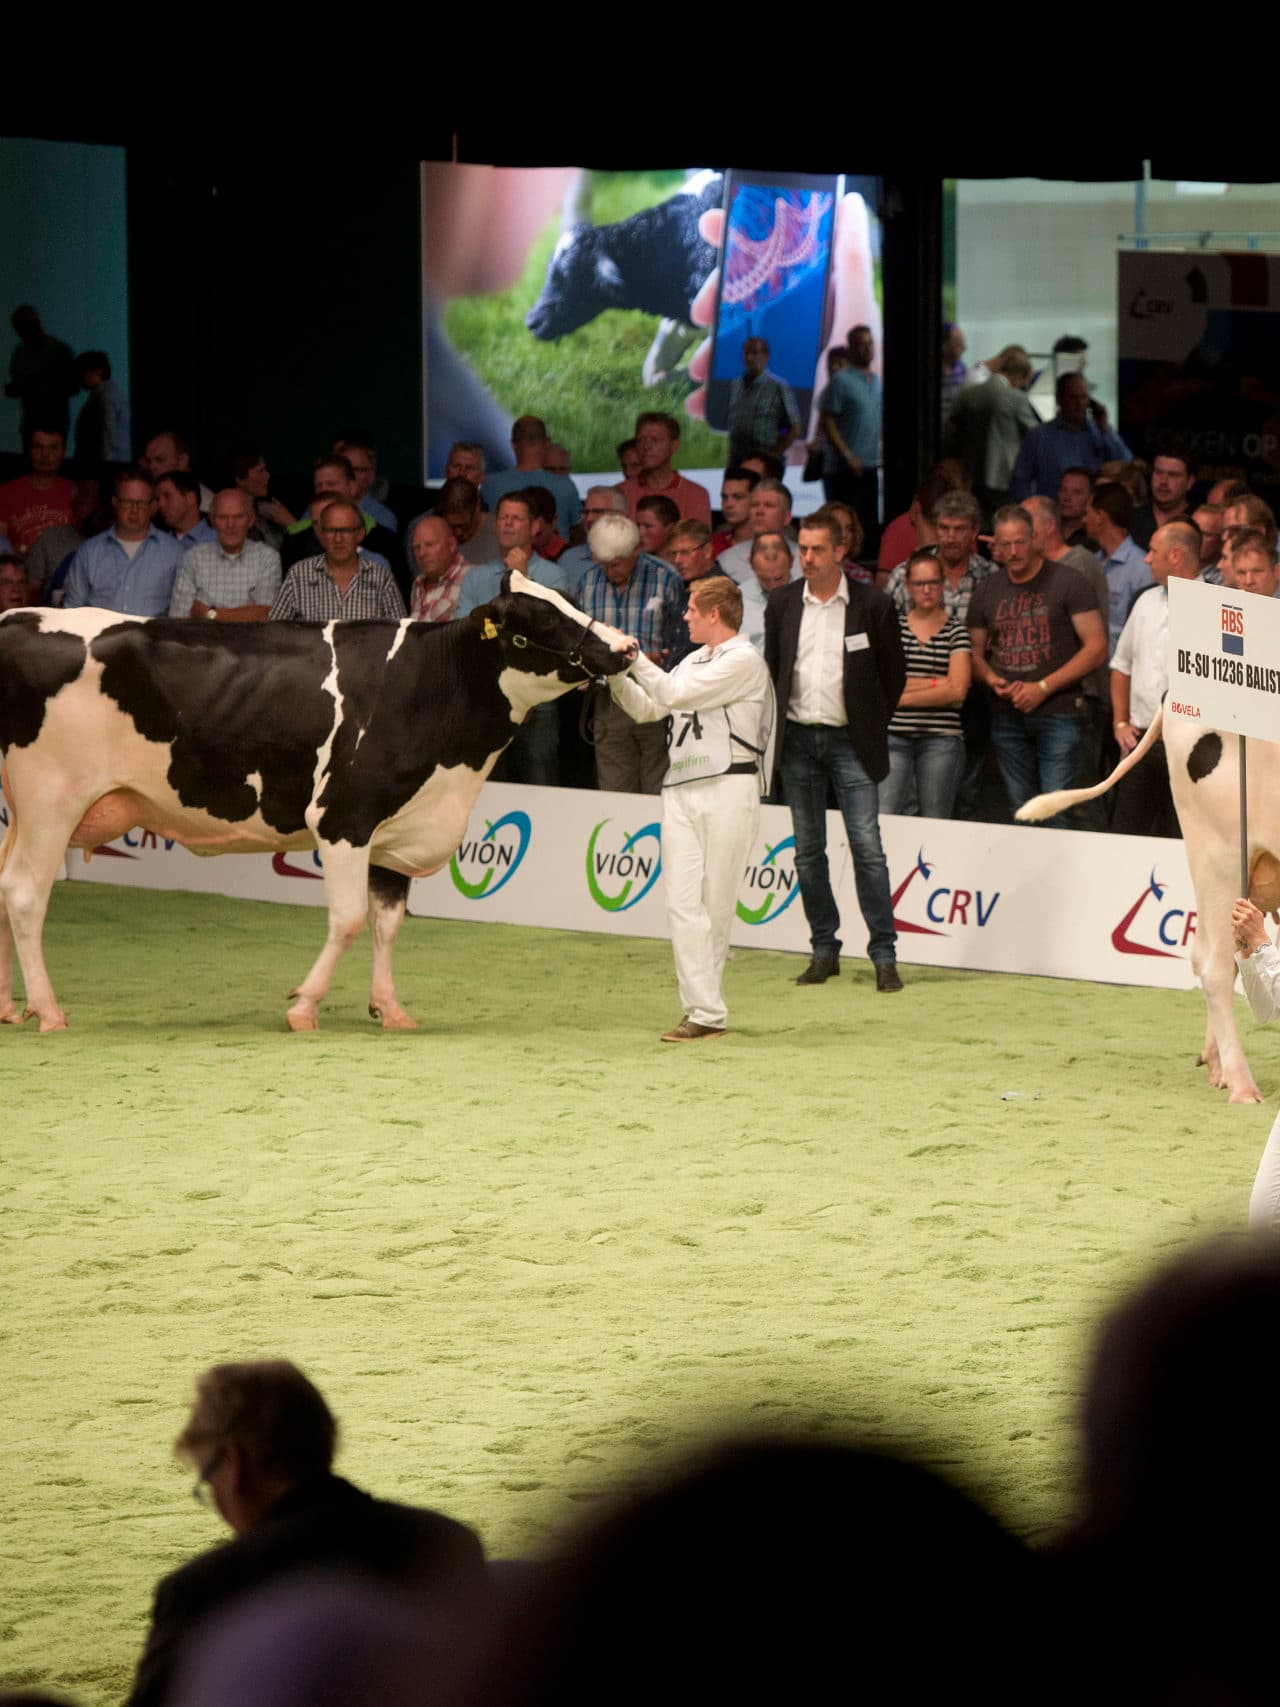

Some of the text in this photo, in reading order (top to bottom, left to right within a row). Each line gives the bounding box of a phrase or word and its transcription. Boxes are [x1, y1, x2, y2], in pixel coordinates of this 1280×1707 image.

[1242, 433, 1279, 459] OP
[1221, 608, 1243, 634] ABS
[1178, 648, 1209, 679] DE-SU
[1212, 656, 1243, 686] 11236
[1171, 702, 1201, 718] BOVELA
[457, 841, 513, 867] VION
[596, 852, 653, 878] VION
[926, 887, 1000, 927] CRV
[1158, 908, 1197, 947] CR
